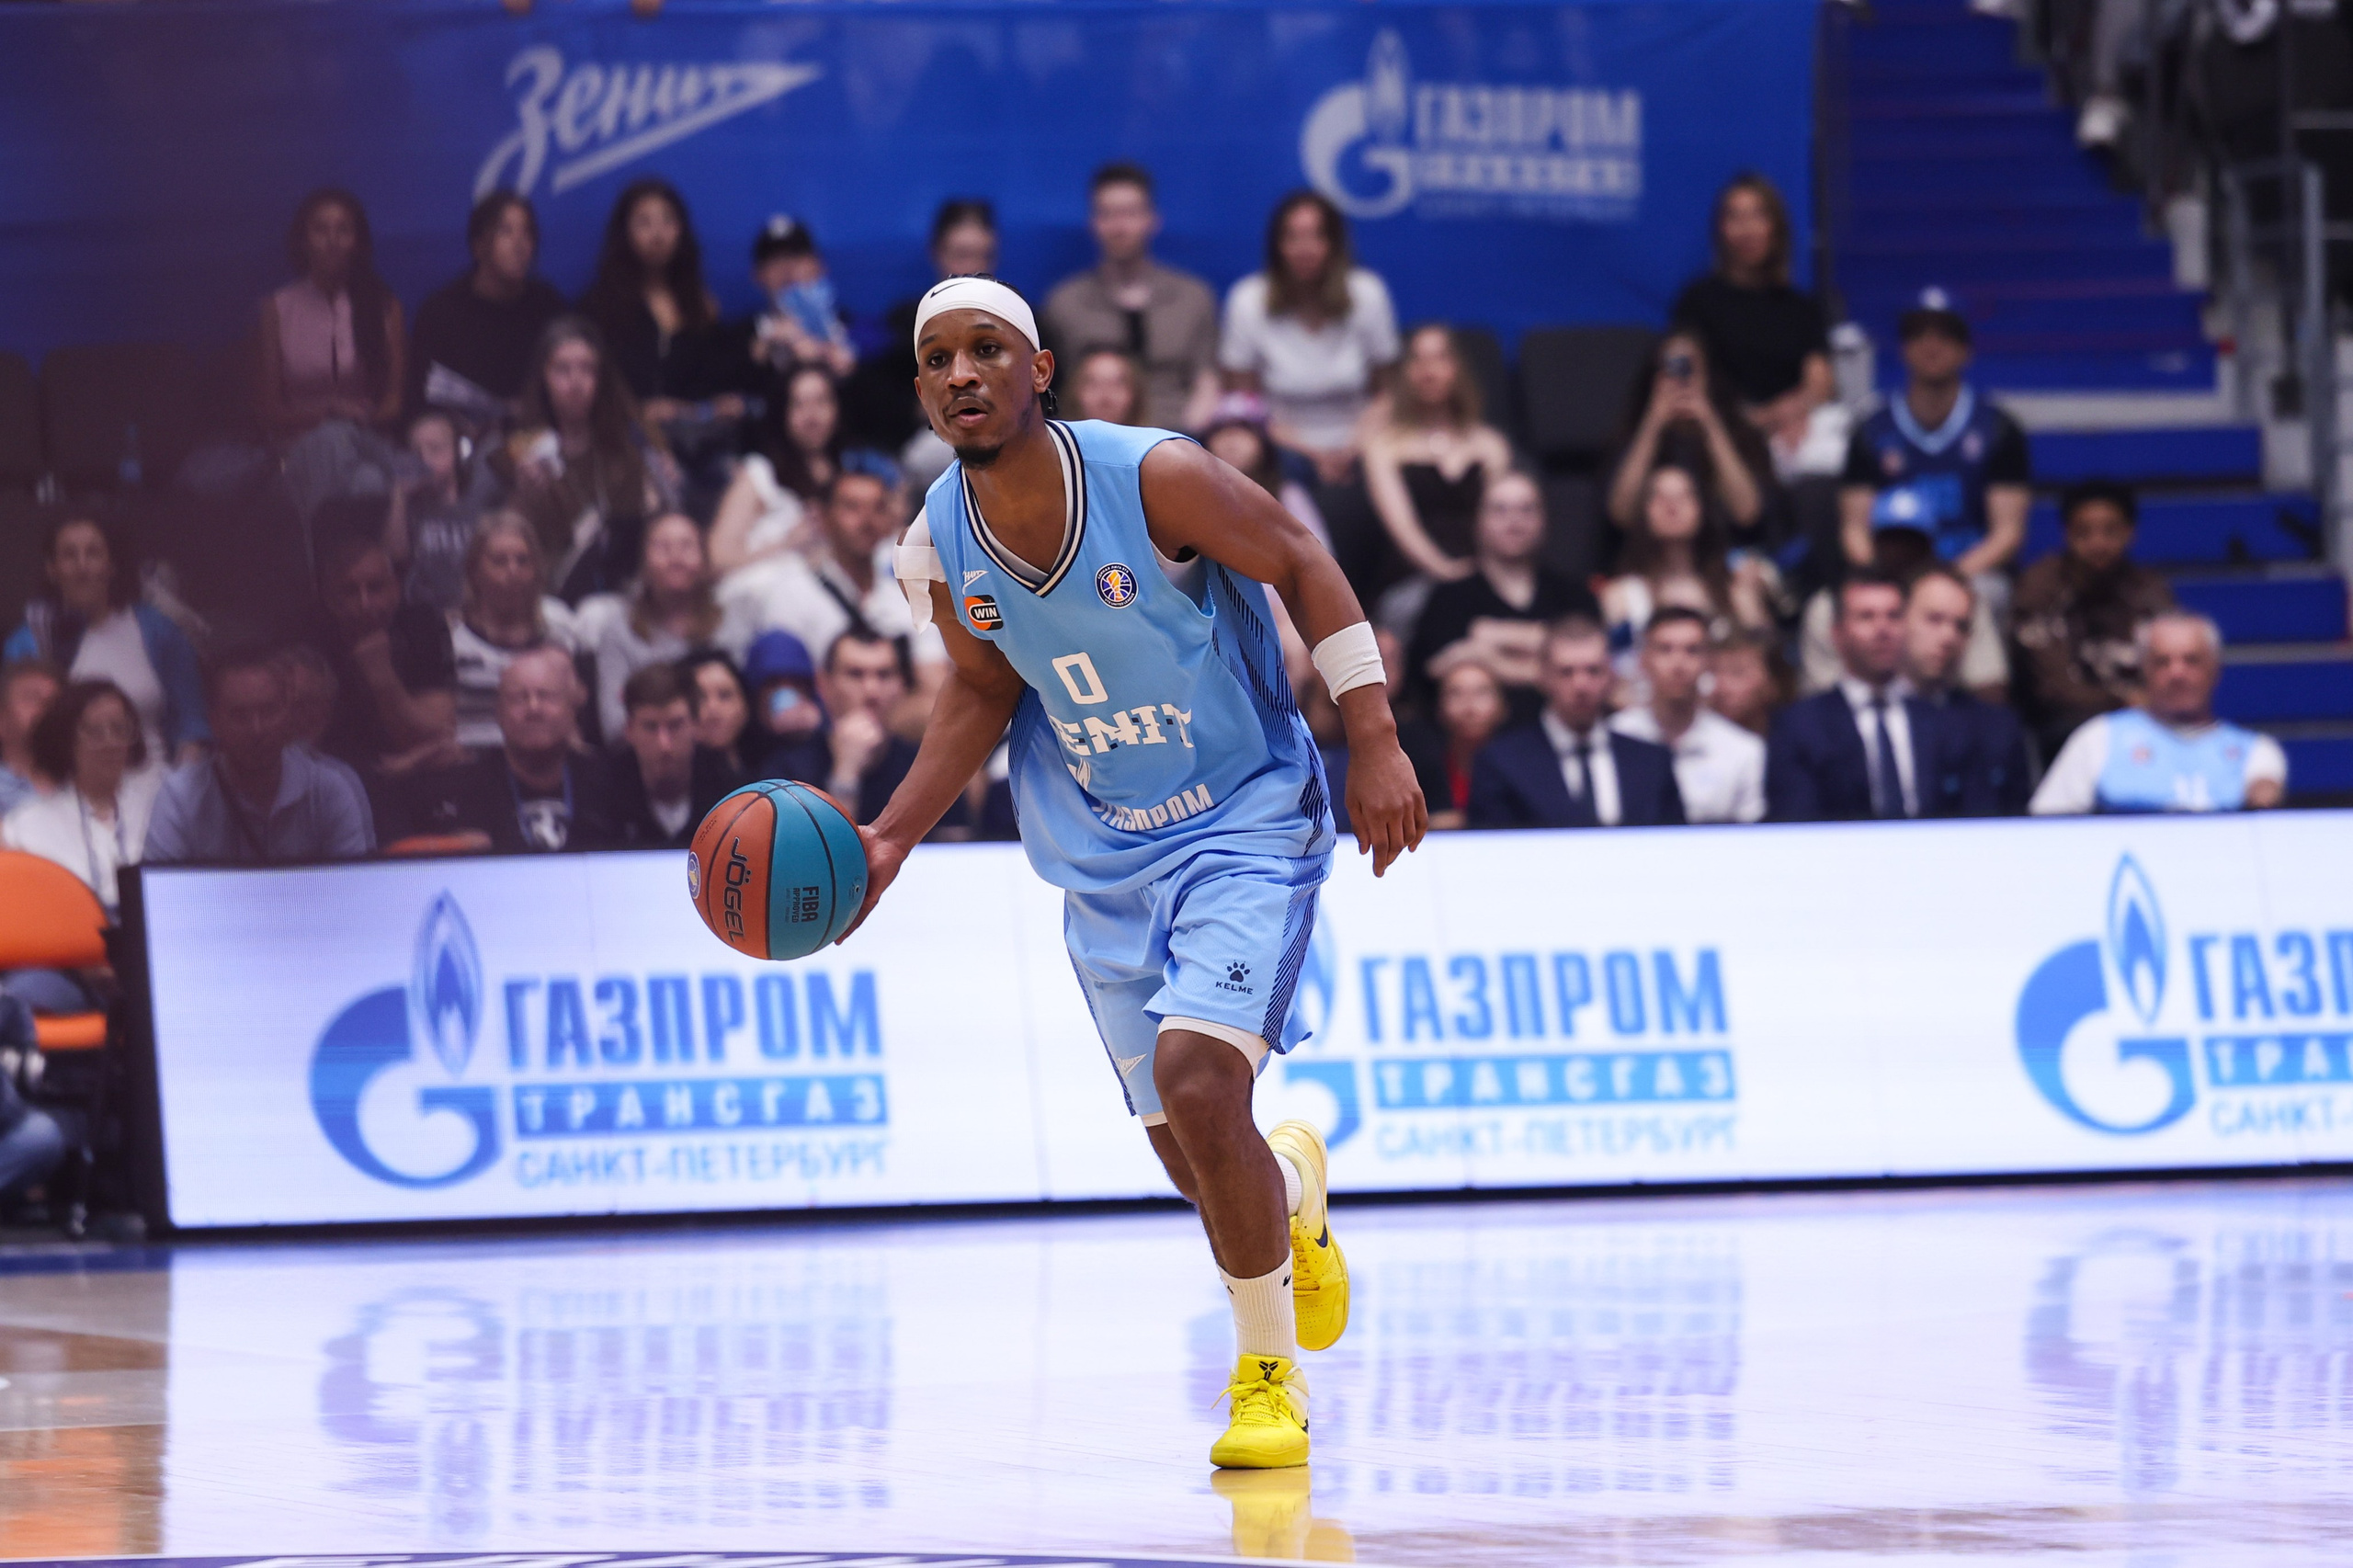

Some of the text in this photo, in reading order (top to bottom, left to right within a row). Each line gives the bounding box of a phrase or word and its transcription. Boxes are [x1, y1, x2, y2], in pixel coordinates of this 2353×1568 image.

[974, 607, 998, 619] WIN
[1051, 652, 1108, 705] 0
[723, 836, 752, 943] JÖGEL
[791, 887, 801, 924] APPROVED
[801, 885, 820, 924] FIBA
[1215, 981, 1254, 995] KELME
[1358, 948, 1730, 1042] ГАЗПРОМ
[502, 971, 883, 1073] ГАЗПРОМ
[1379, 1054, 1732, 1103] ТРАНСГАЗ
[2214, 1040, 2353, 1084] ТРА
[517, 1078, 884, 1131] ТРАНСГАЗ
[1377, 1115, 1736, 1158] САНКТ-ПЕТЕРБУРГ
[517, 1140, 890, 1189] САНКТ-ПЕТЕРБУРГ
